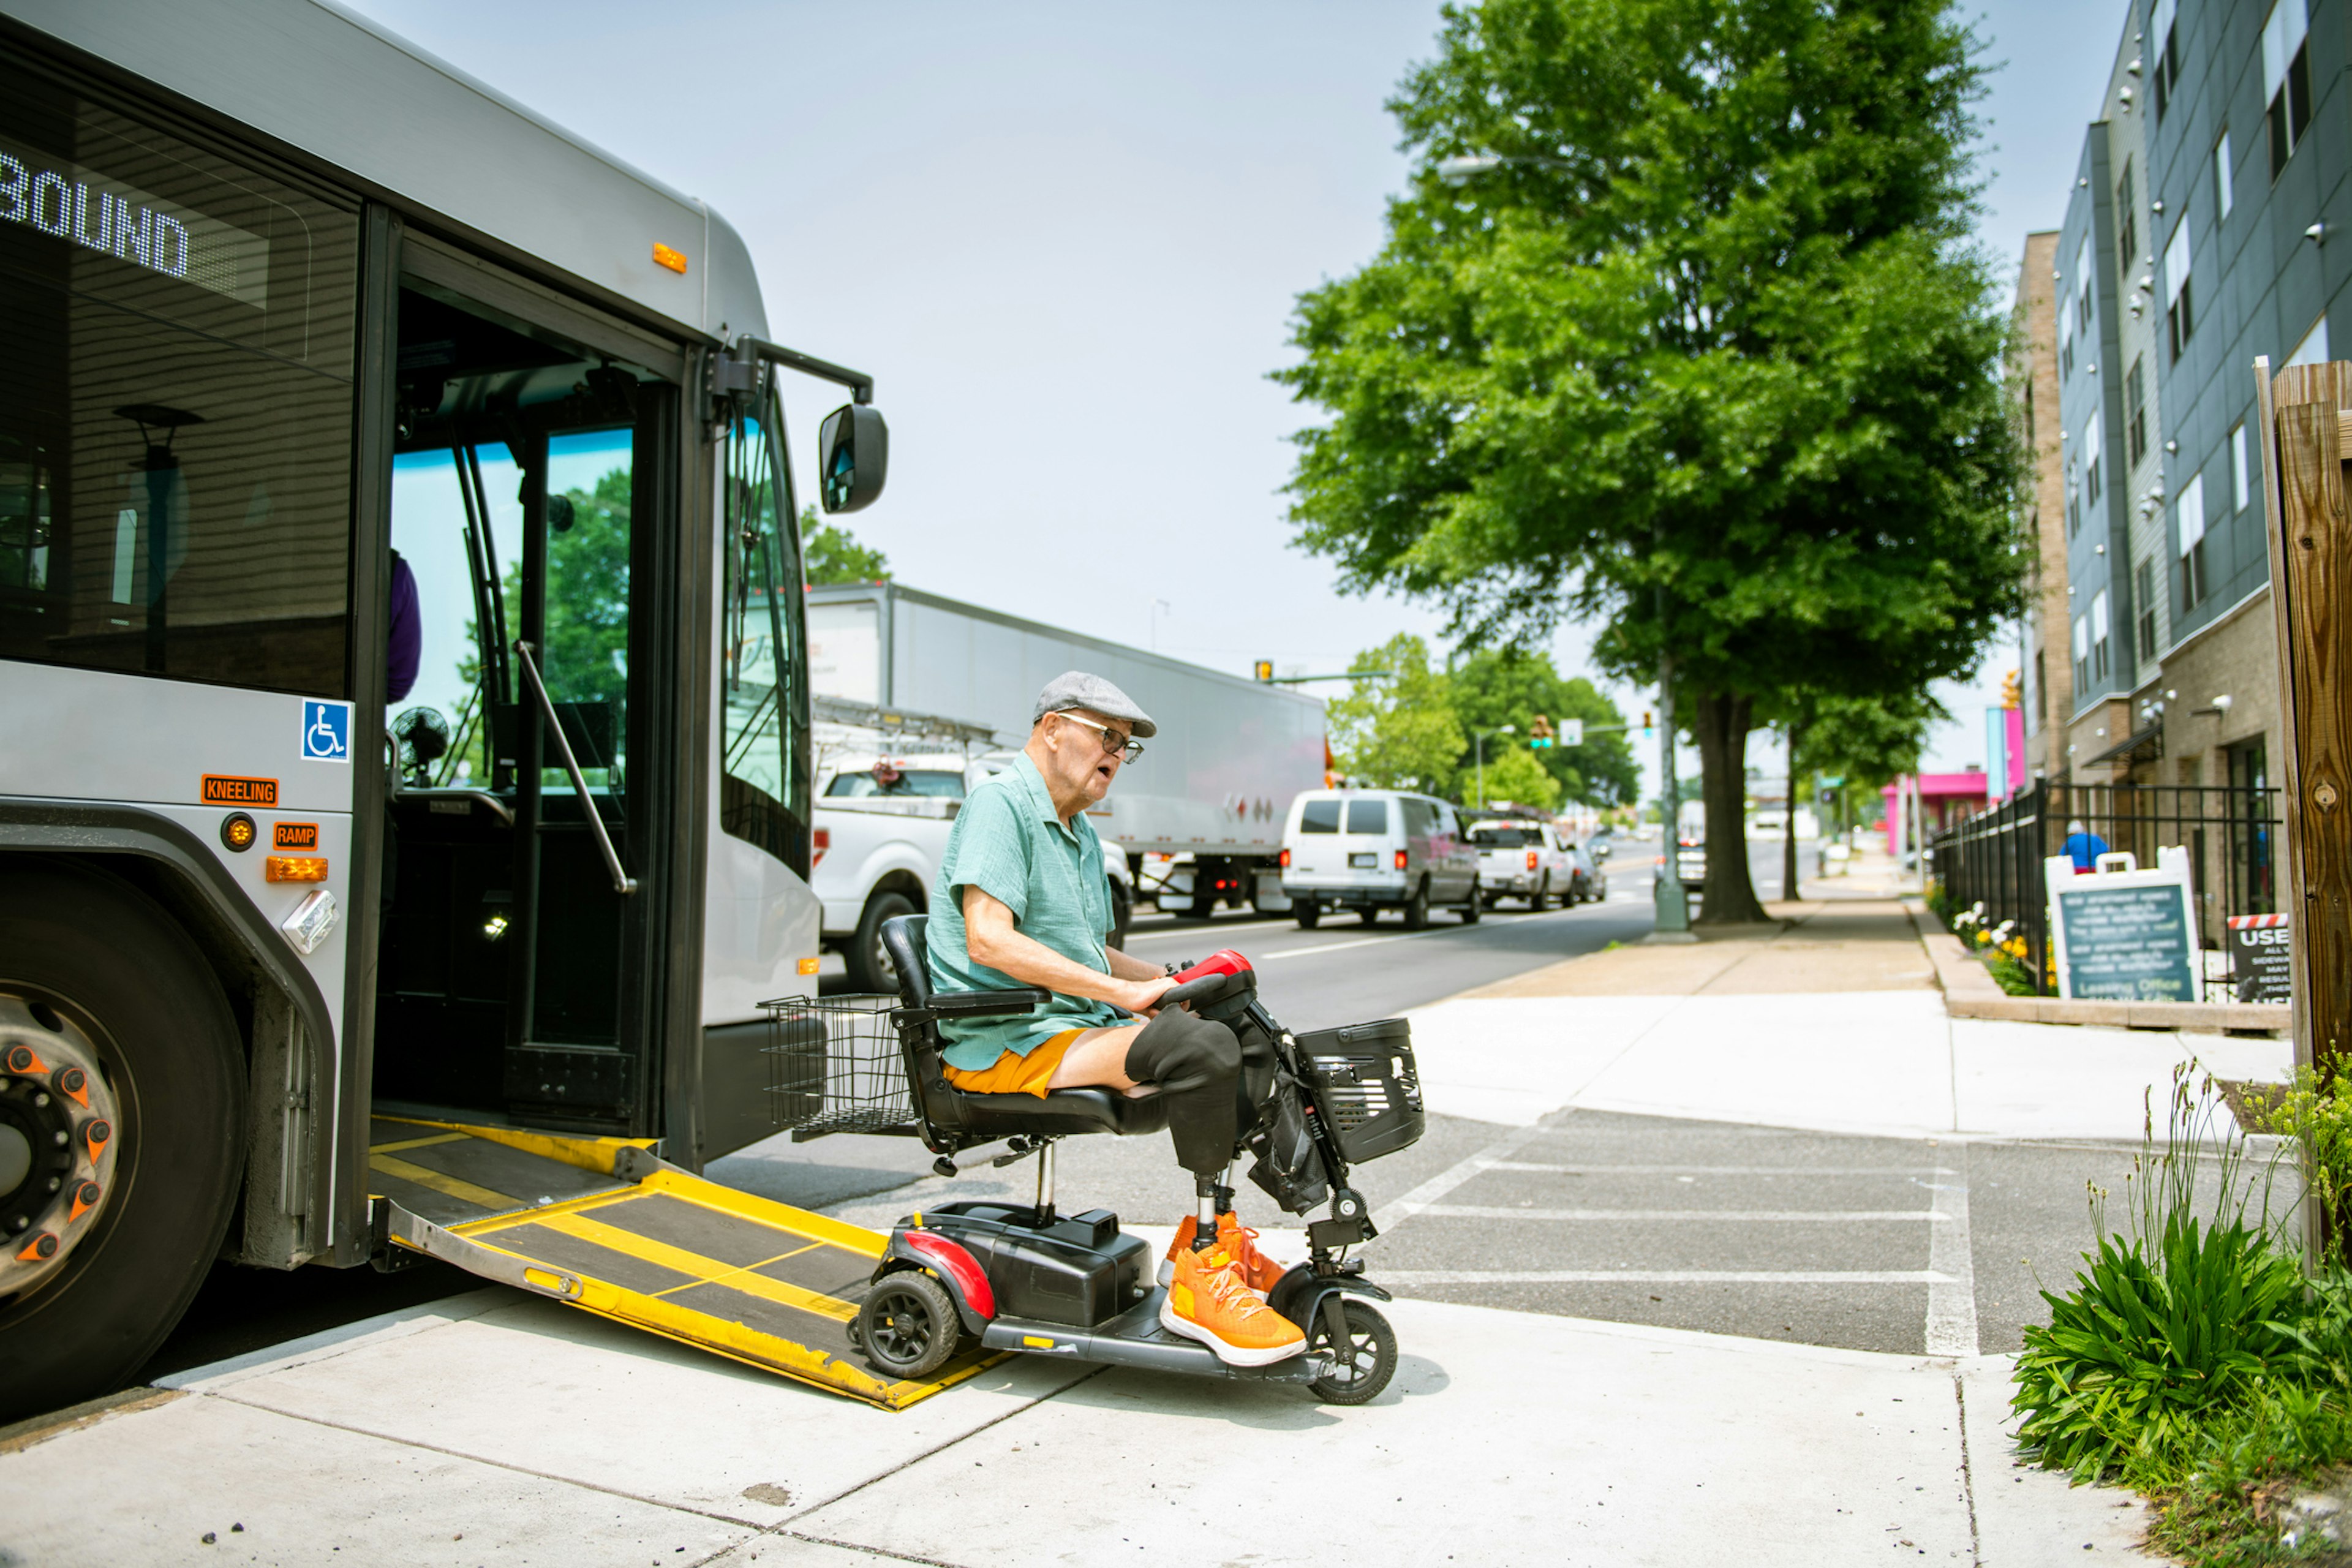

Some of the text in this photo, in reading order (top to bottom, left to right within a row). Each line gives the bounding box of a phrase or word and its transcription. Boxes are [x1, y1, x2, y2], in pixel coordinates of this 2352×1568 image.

[0, 151, 189, 277] BOUND
[207, 780, 274, 801] KNEELING
[277, 827, 315, 843] RAMP
[2239, 929, 2289, 946] USE
[2079, 979, 2181, 995] Leasing Office
